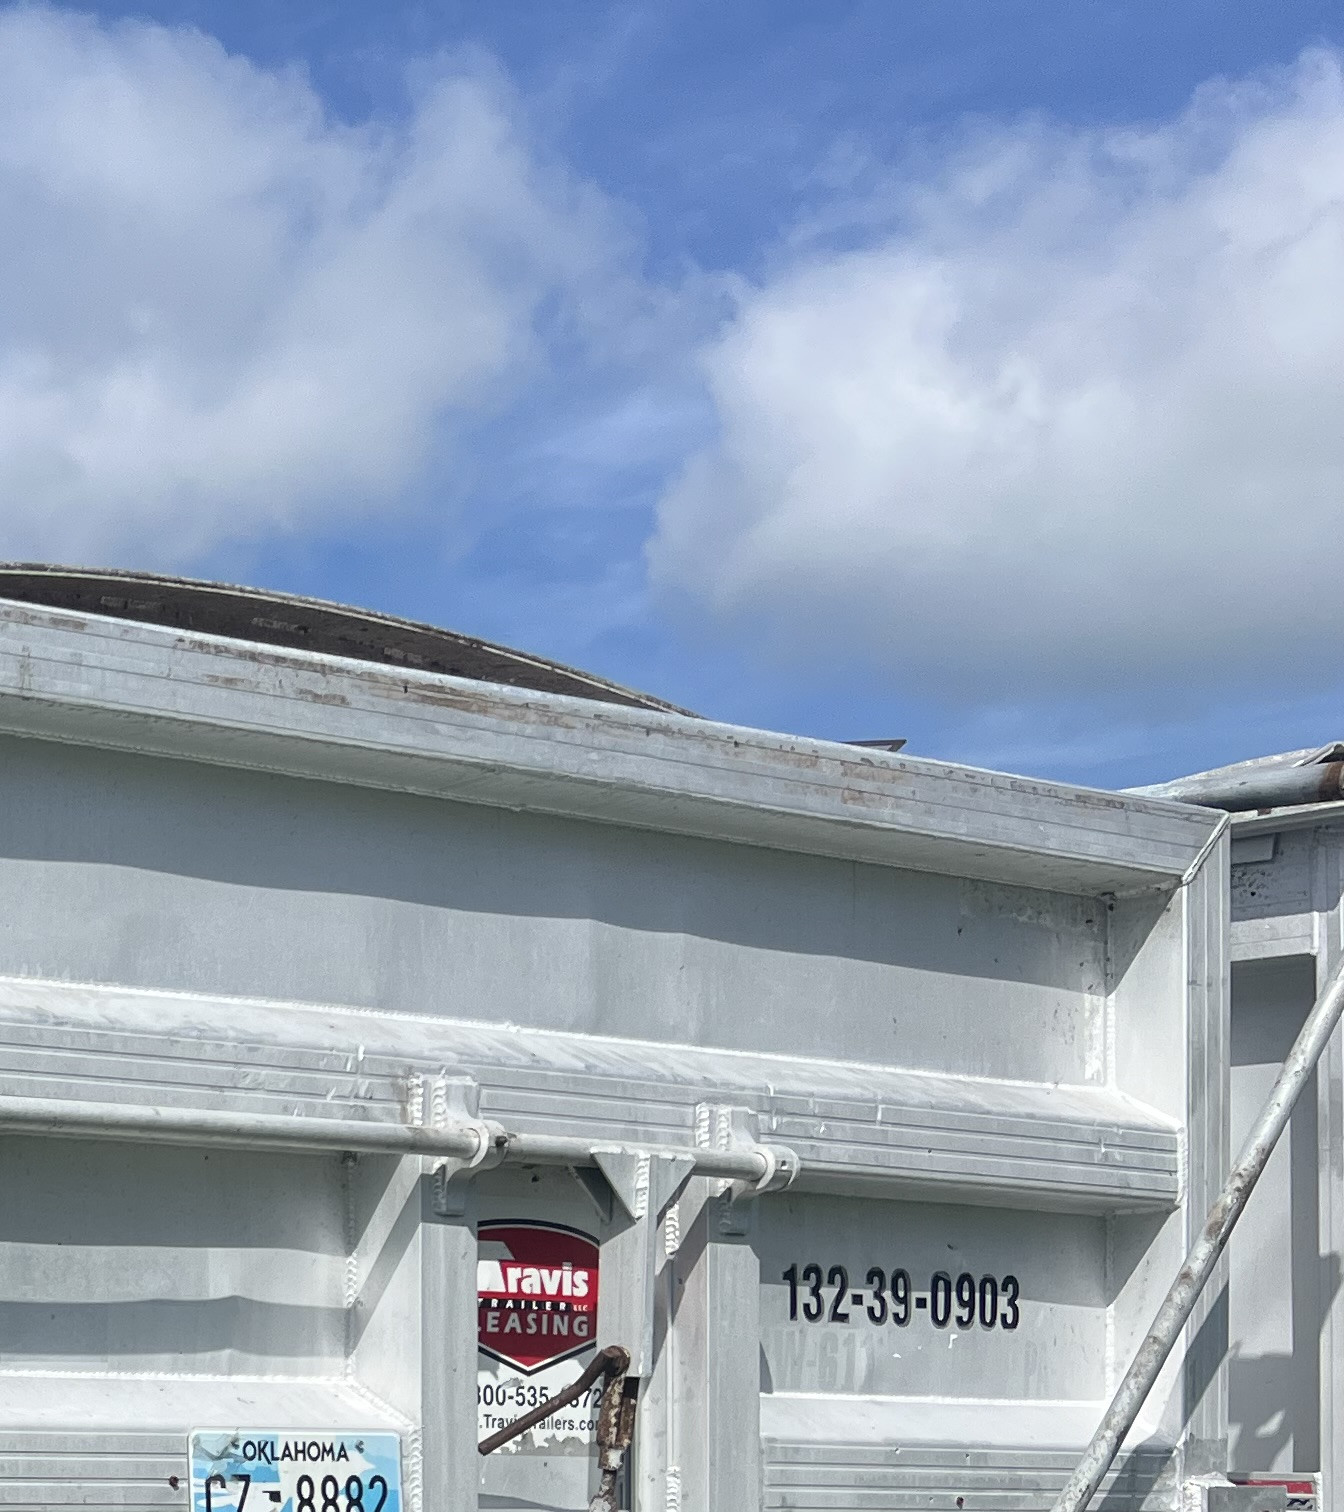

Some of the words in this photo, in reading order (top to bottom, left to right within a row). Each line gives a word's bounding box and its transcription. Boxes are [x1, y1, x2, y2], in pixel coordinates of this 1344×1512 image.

[782, 1263, 1020, 1331] 132-39-0903
[478, 1311, 589, 1337] EASING
[242, 1440, 350, 1465] OKLAHOMA
